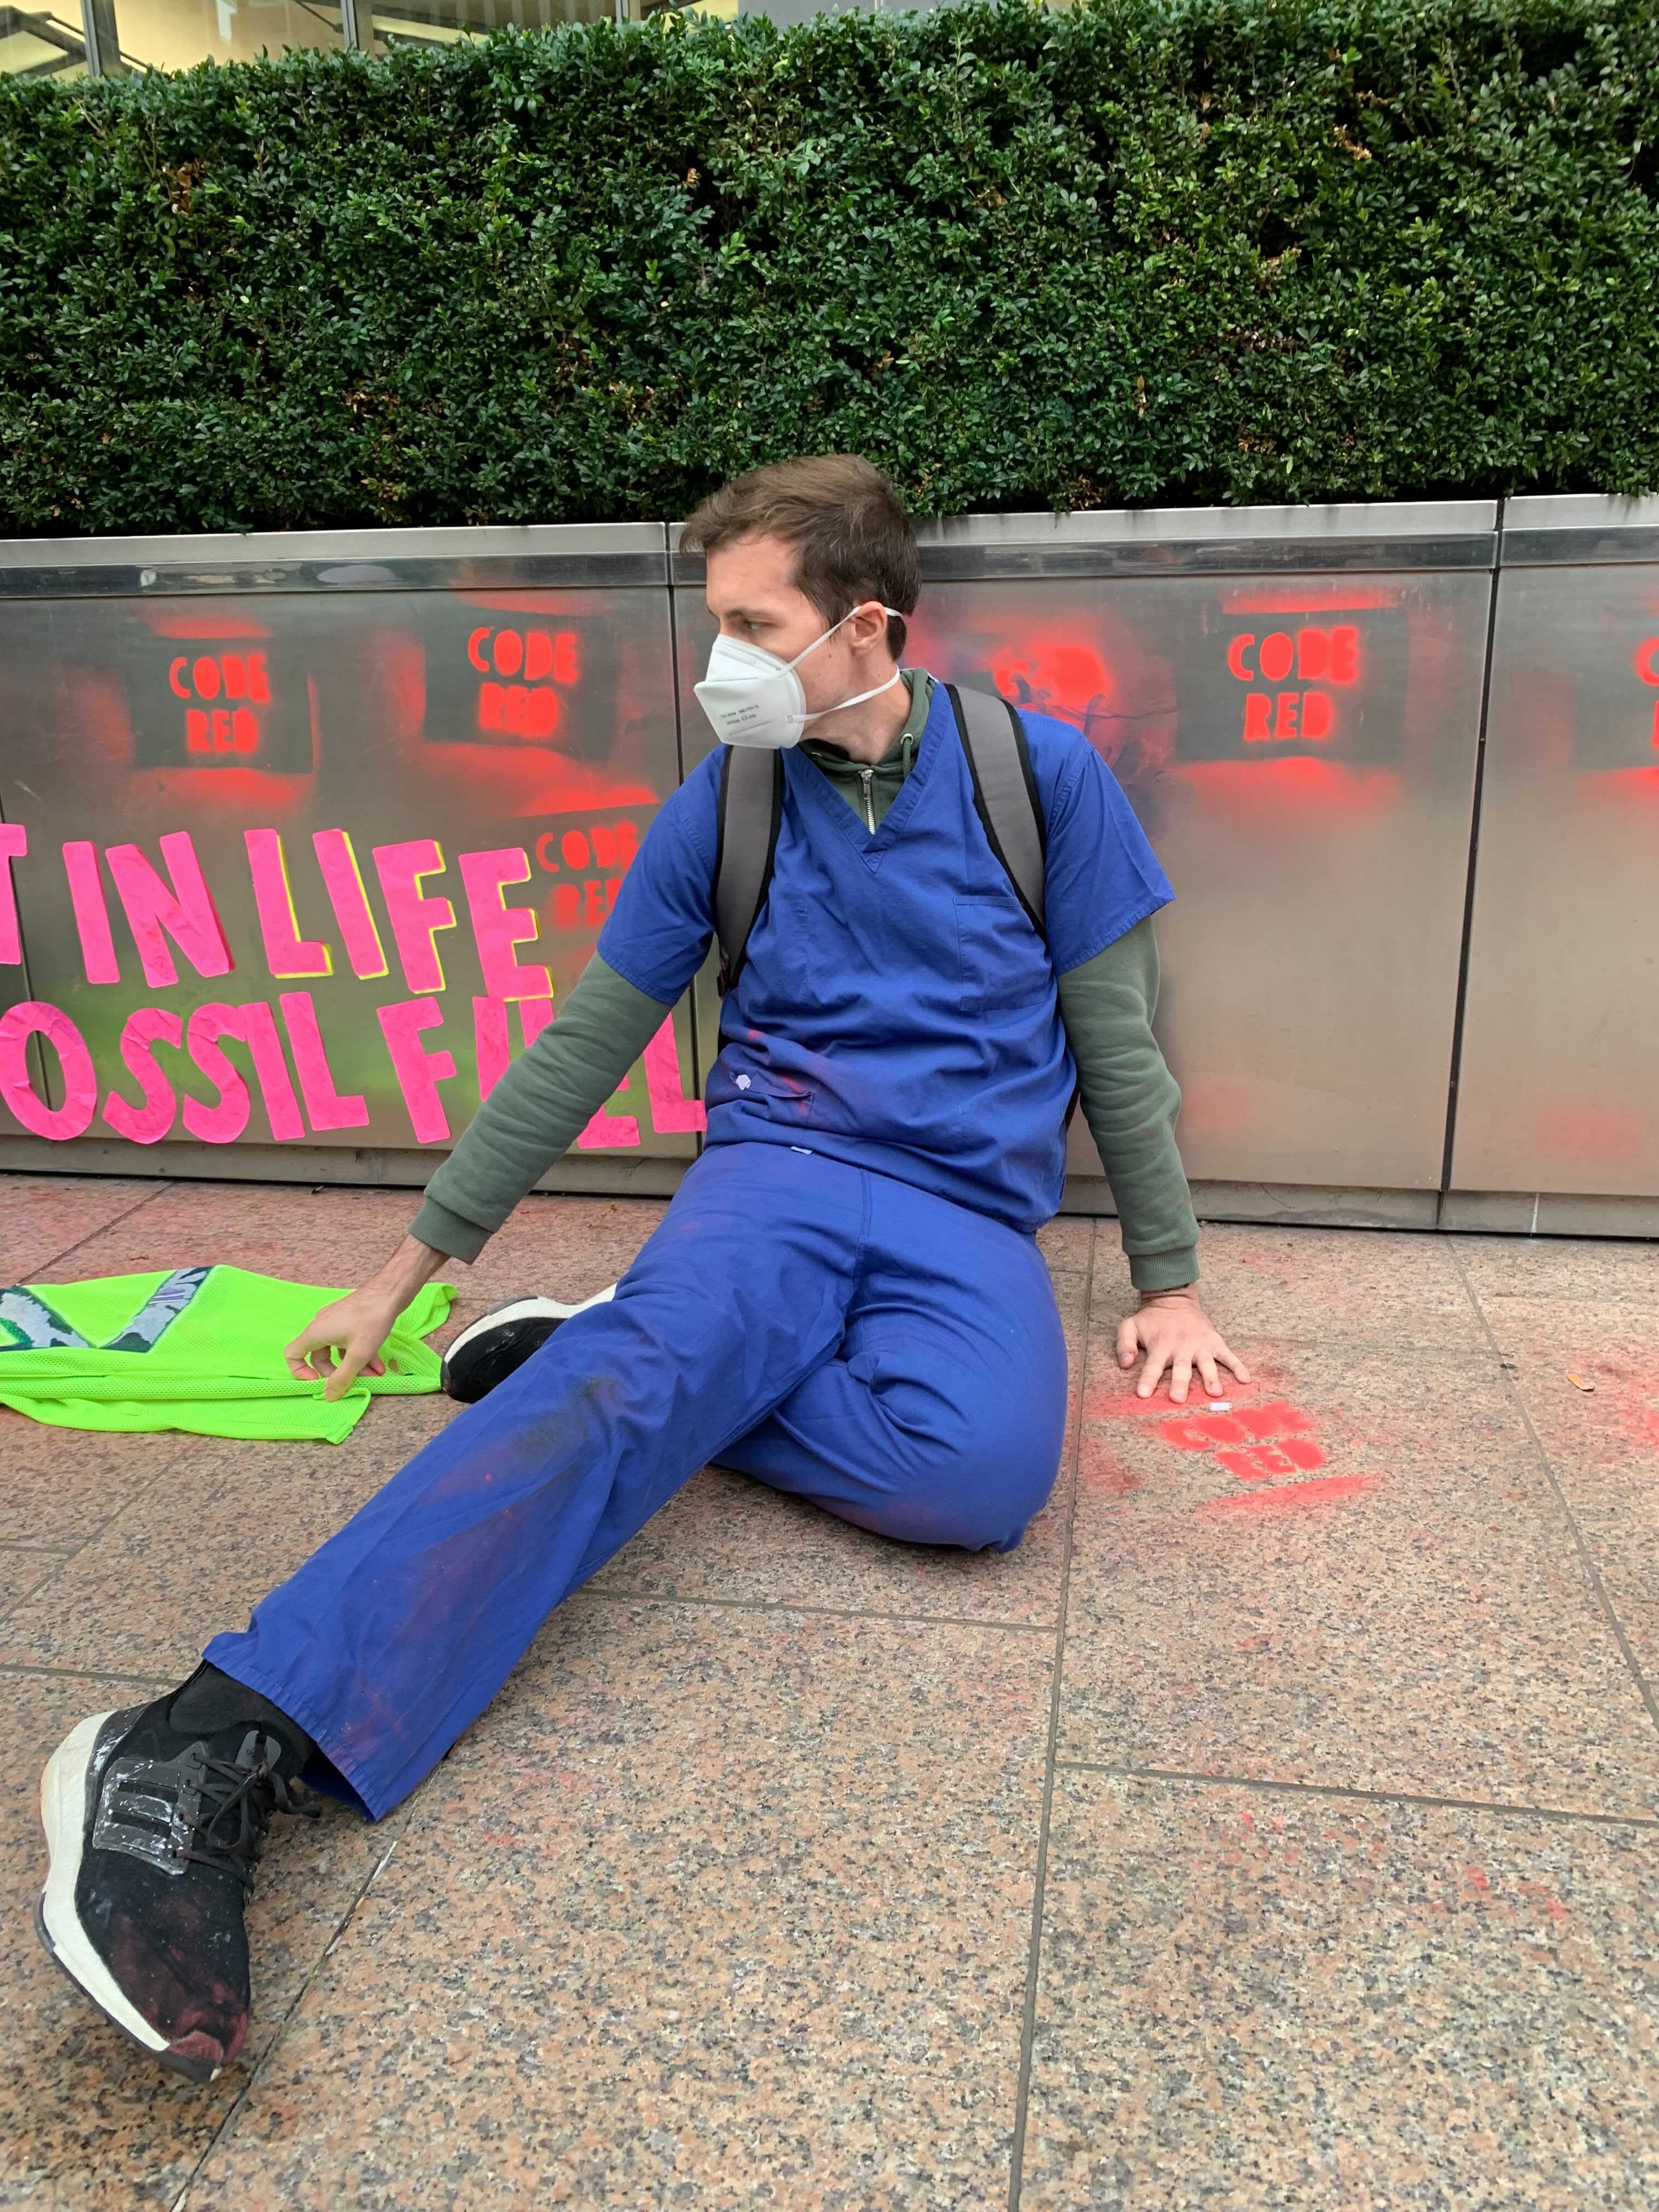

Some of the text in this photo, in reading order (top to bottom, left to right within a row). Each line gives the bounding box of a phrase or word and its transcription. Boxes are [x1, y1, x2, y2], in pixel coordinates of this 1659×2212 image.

[169, 654, 271, 704] CODE
[469, 627, 579, 686] CODE
[1227, 626, 1359, 685] CODE
[185, 707, 258, 754] RED
[478, 682, 562, 738] RED
[1243, 691, 1333, 742] RED
[535, 821, 639, 873] CODE
[63, 831, 235, 988] IN
[244, 828, 554, 1002] LIFE
[376, 996, 708, 1150] FL
[1159, 1402, 1316, 1450] CODE
[1215, 1440, 1325, 1480] RED
